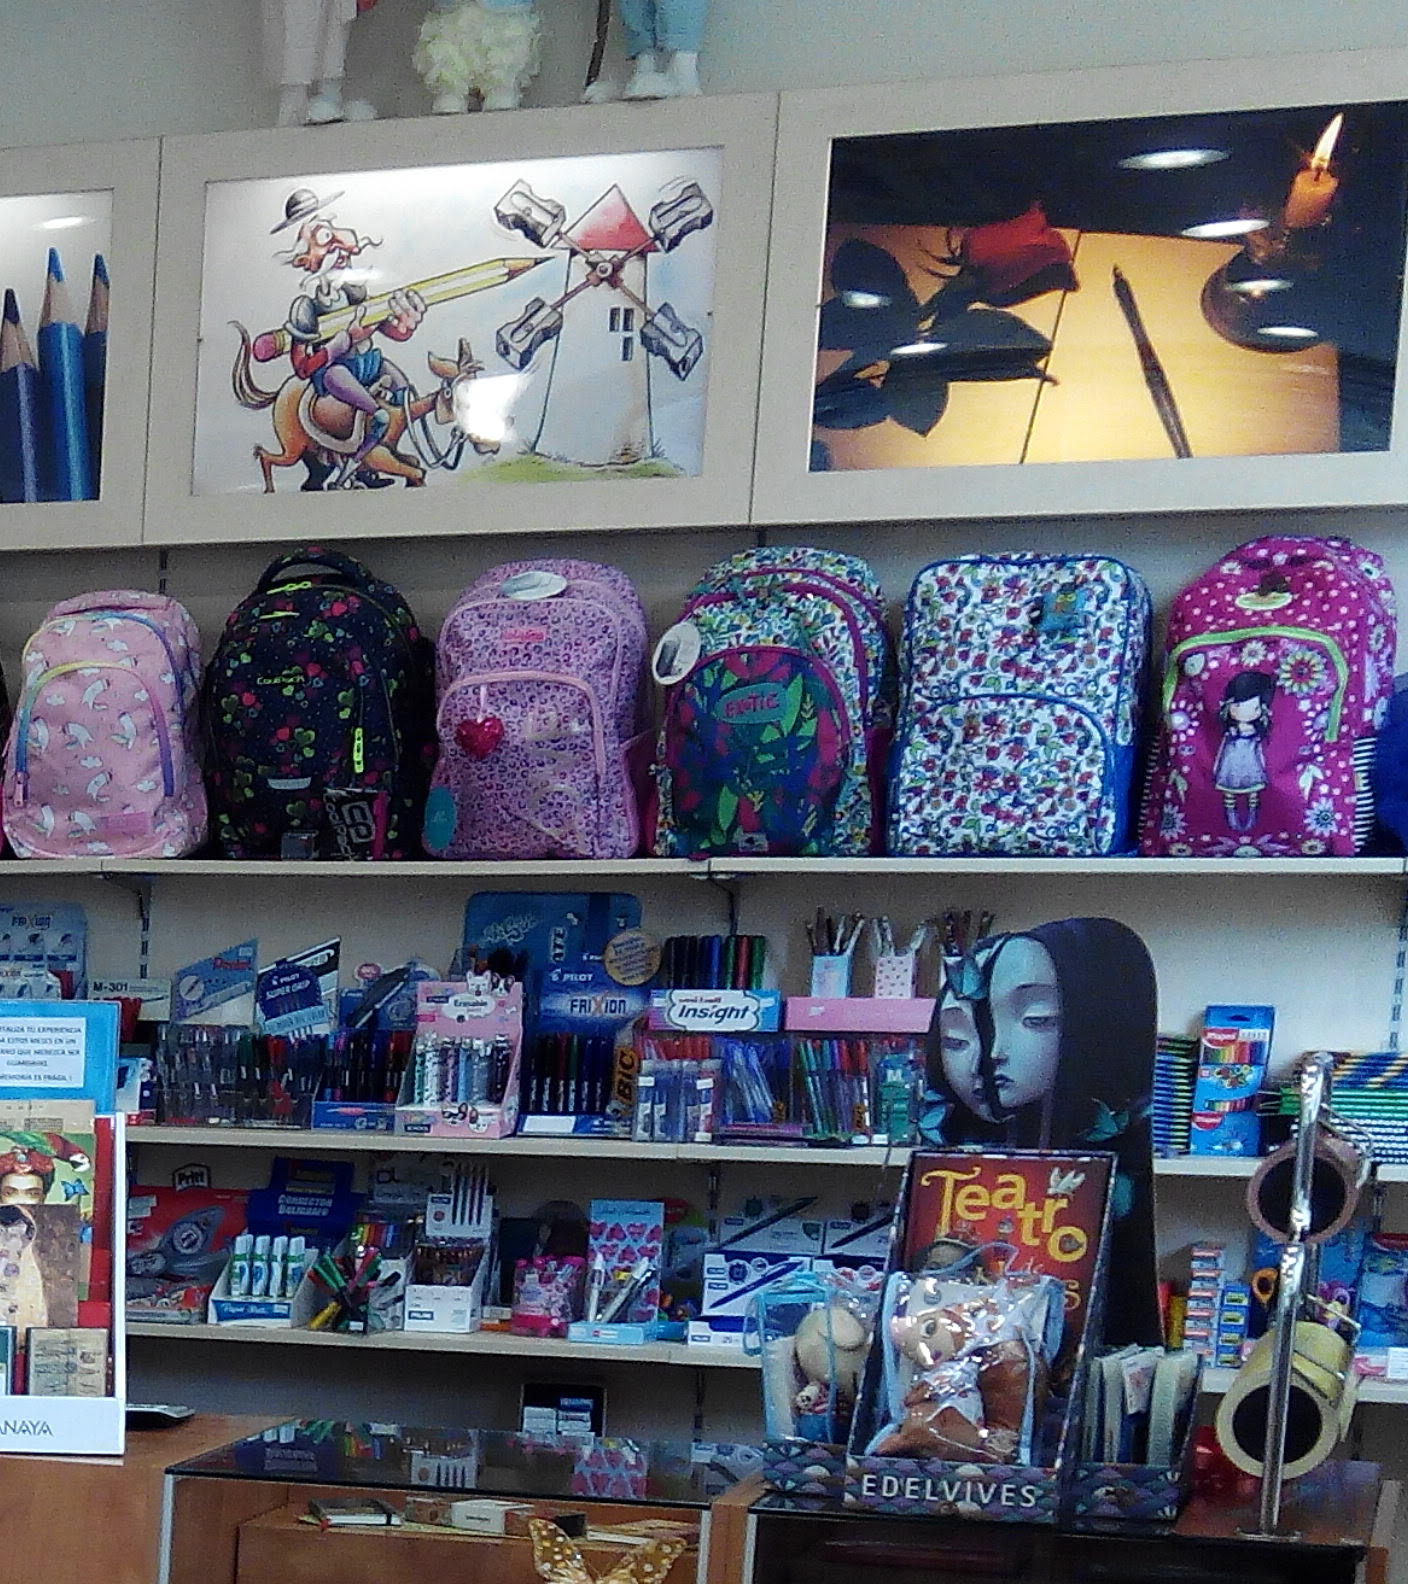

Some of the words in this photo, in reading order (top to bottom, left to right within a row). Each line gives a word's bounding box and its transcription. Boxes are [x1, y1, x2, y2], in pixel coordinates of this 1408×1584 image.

[93, 982, 129, 993] M-301
[678, 1003, 750, 1024] Insight
[921, 1166, 1088, 1263] Teatro
[862, 1474, 1037, 1508] EDELVIVES
